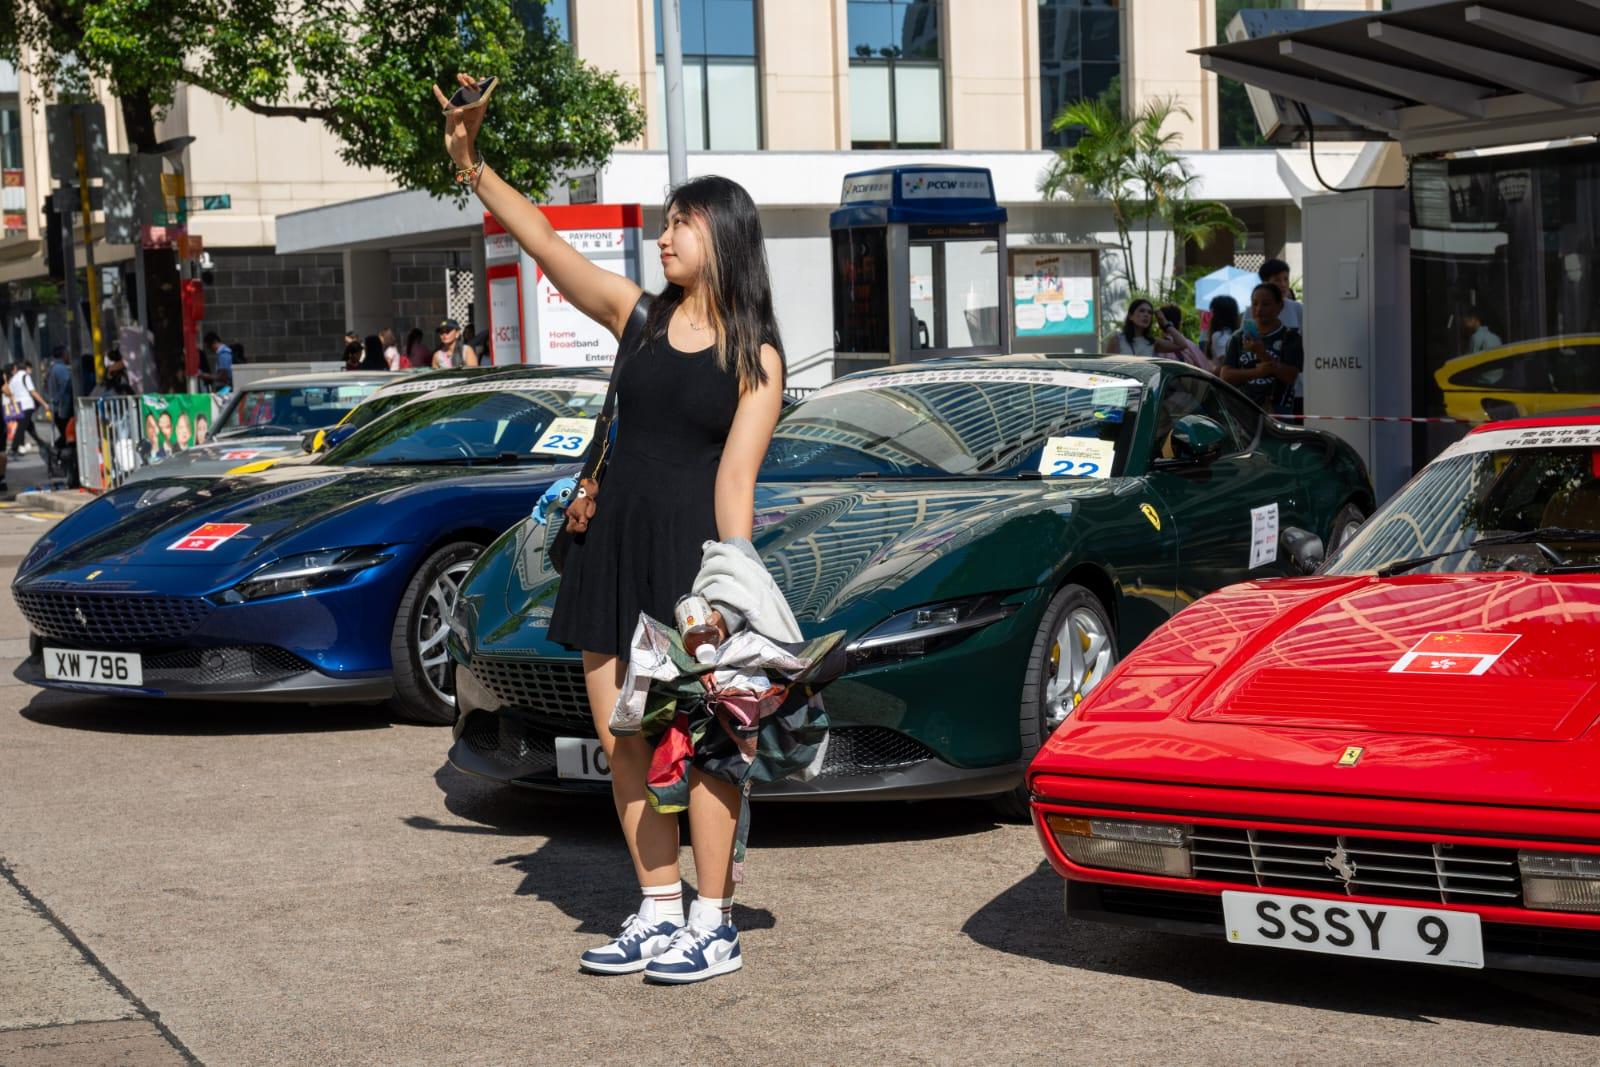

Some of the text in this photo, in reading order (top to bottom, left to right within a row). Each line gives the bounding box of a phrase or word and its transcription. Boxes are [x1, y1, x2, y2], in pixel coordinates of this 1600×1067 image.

[927, 181, 957, 189] PCCW
[569, 232, 613, 240] PAYPHONE
[549, 331, 576, 339] Home
[549, 340, 599, 348] Broadband
[585, 354, 616, 362] Enterp
[1314, 357, 1363, 369] CHANEL
[542, 434, 584, 450] 23
[1050, 460, 1100, 477] 22
[55, 652, 128, 680] XW 796
[1256, 900, 1450, 956] SSSY 9
